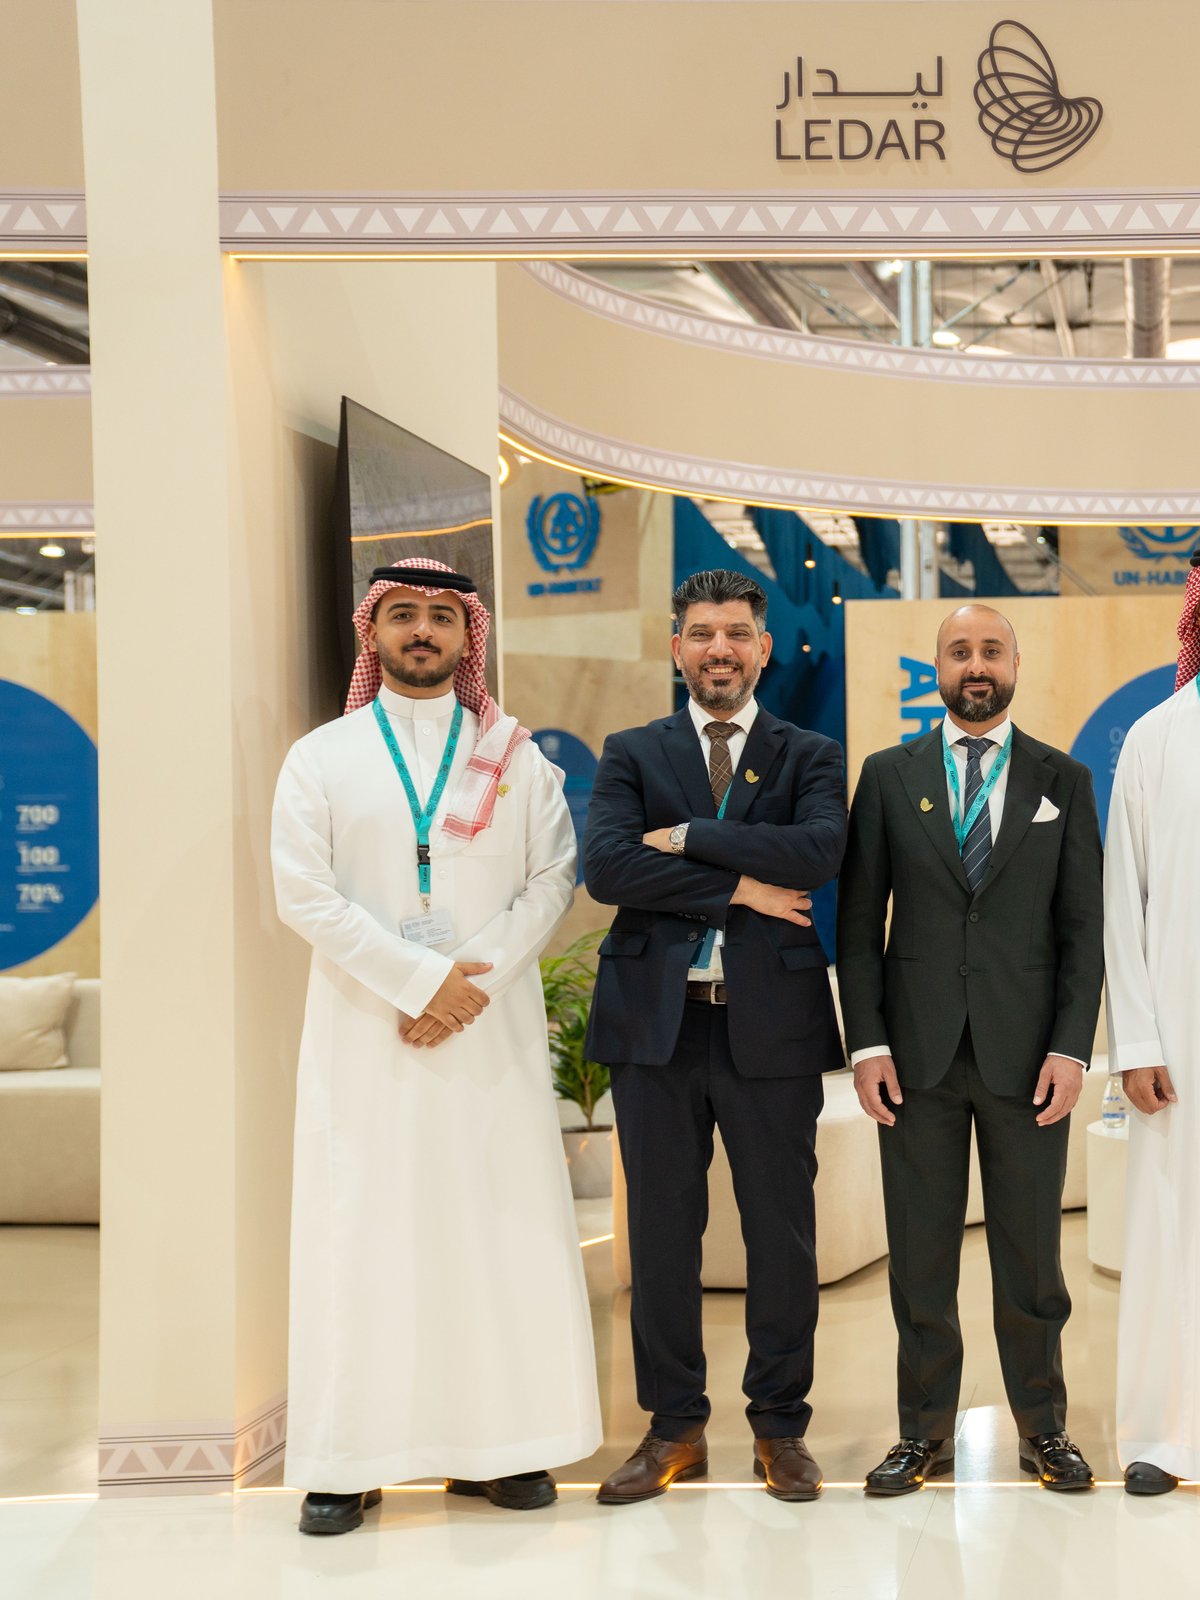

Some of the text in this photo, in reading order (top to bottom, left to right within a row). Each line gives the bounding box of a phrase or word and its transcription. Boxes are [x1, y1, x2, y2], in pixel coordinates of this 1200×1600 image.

[775, 56, 943, 110] ليدار
[775, 119, 946, 161] LEDAR
[1113, 571, 1187, 586] UN-HAB
[16, 883, 64, 904] 70%
